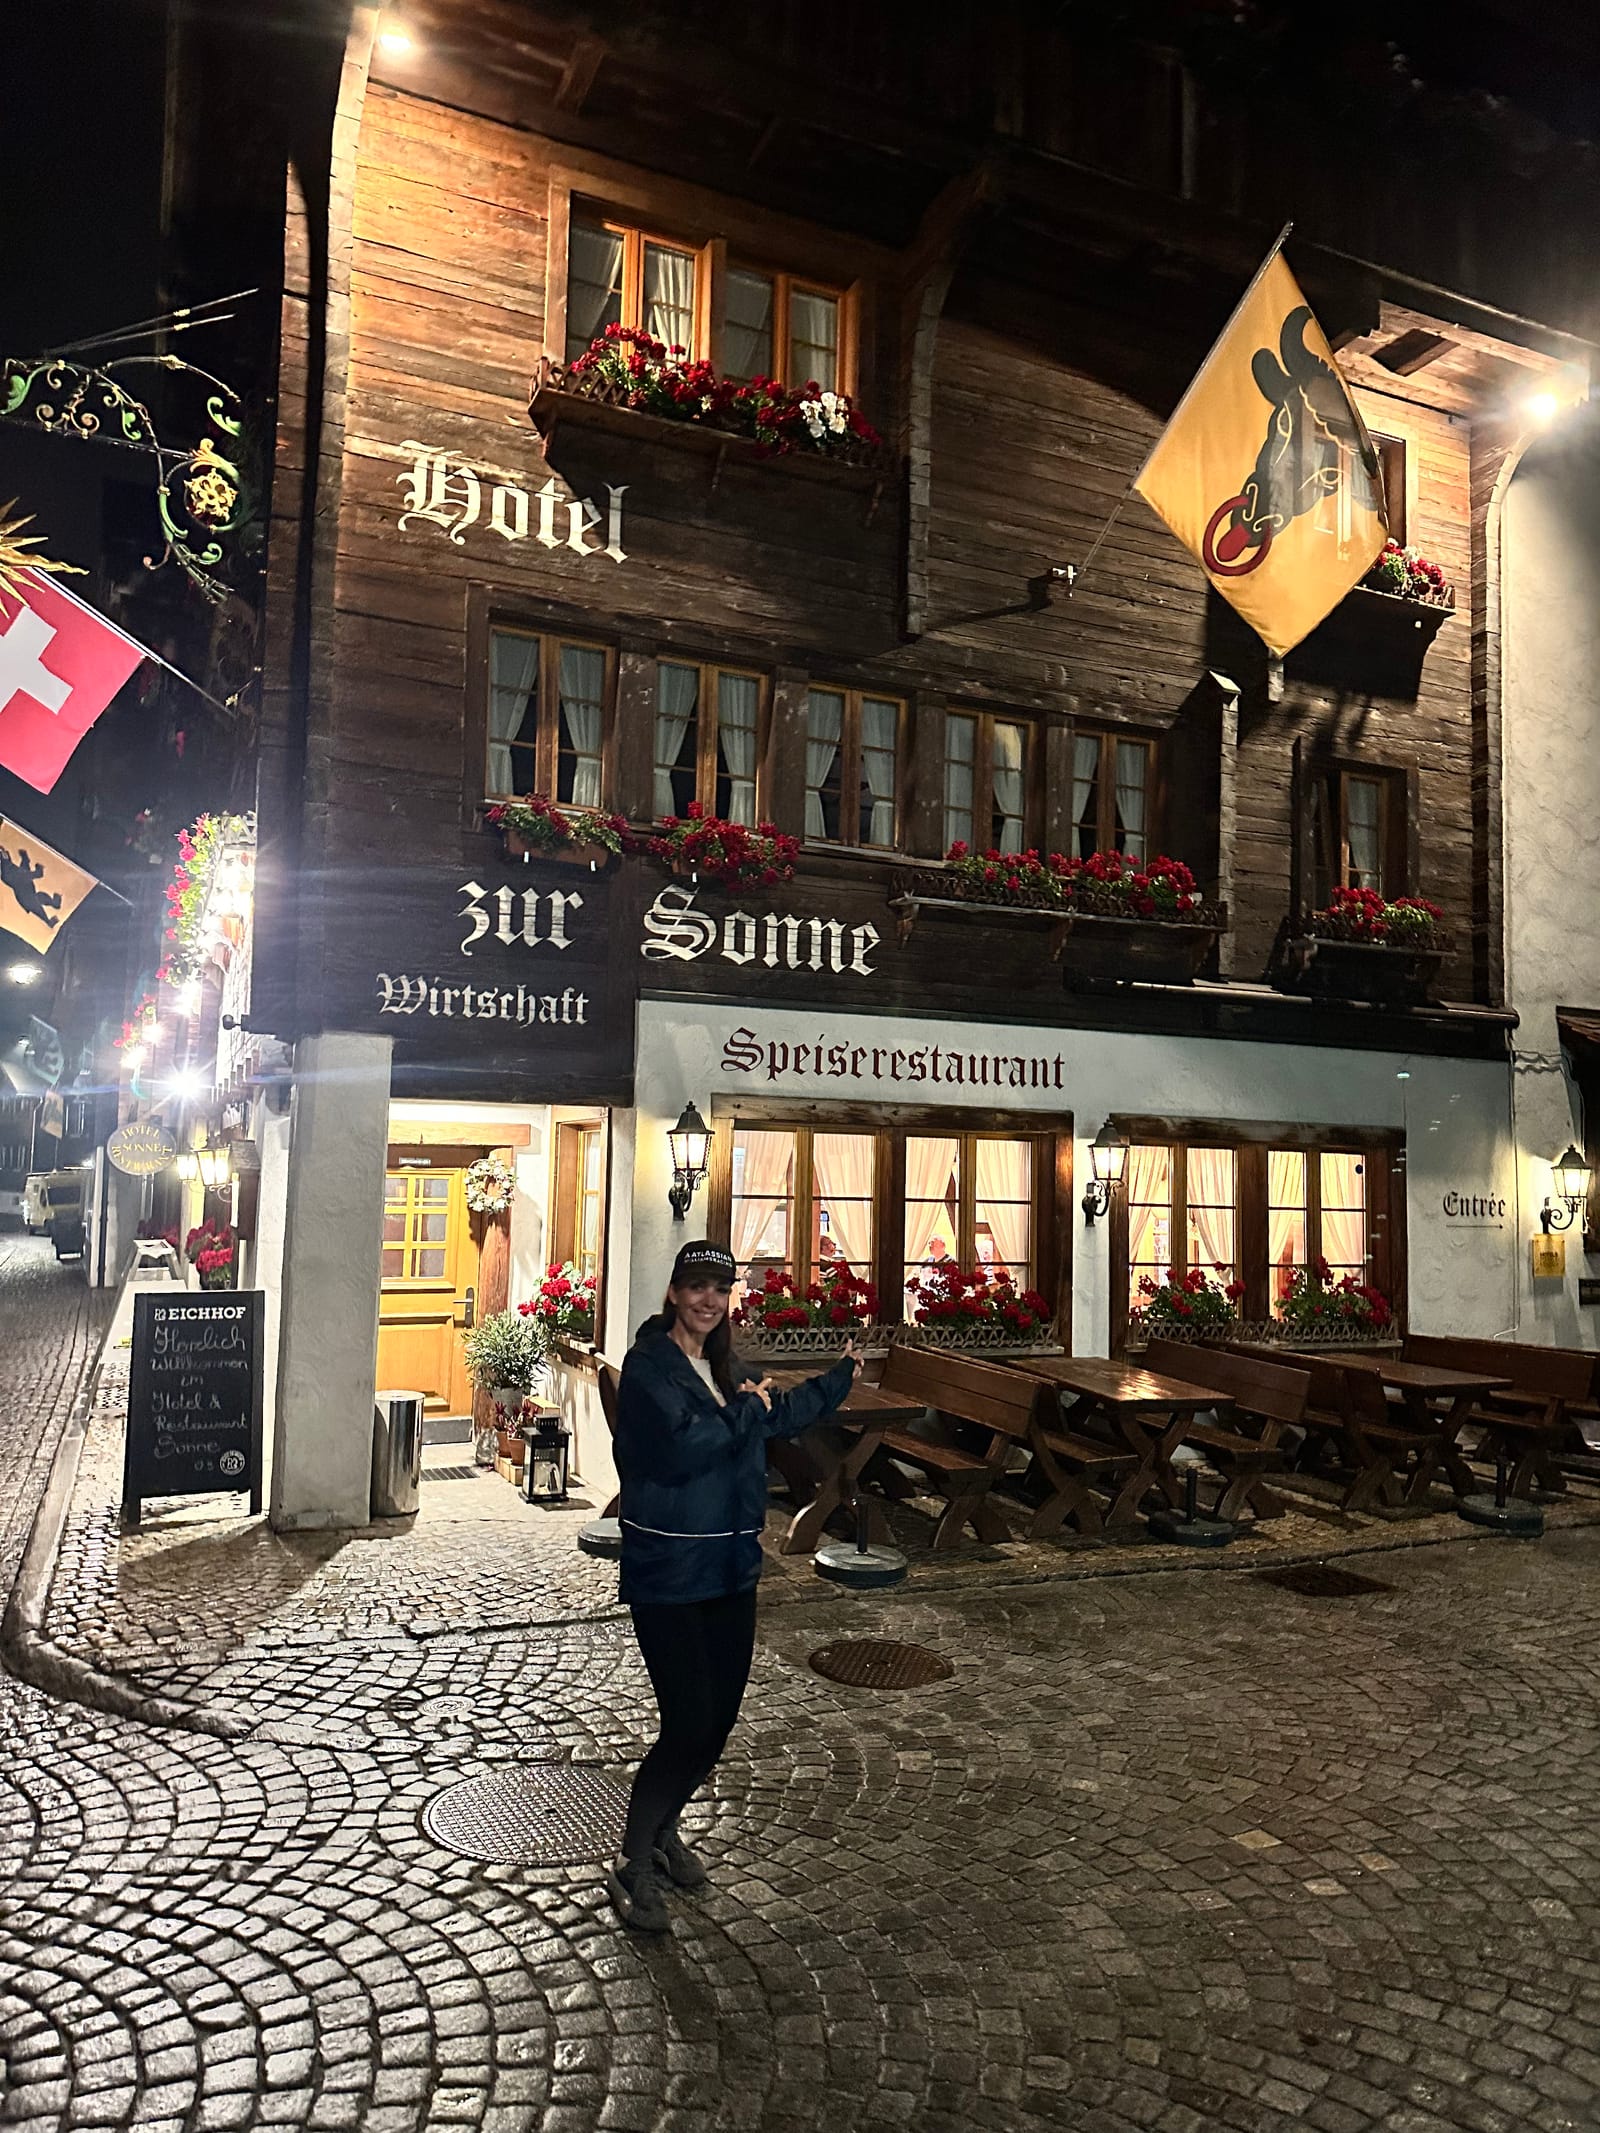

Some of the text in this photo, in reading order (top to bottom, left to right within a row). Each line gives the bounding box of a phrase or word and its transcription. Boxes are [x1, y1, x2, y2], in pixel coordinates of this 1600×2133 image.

[397, 440, 629, 563] Hotel
[457, 880, 881, 976] zur Sonne
[376, 973, 590, 1029] Wirtschaft
[720, 1027, 1065, 1090] Speiserestaurant
[121, 1125, 160, 1140] HOTEL
[122, 1143, 161, 1152] SONNE
[1443, 1191, 1506, 1217] Entrée
[168, 1306, 246, 1321] EICHHOF
[152, 1391, 202, 1413] Hotel
[153, 1433, 220, 1459] Sonne
